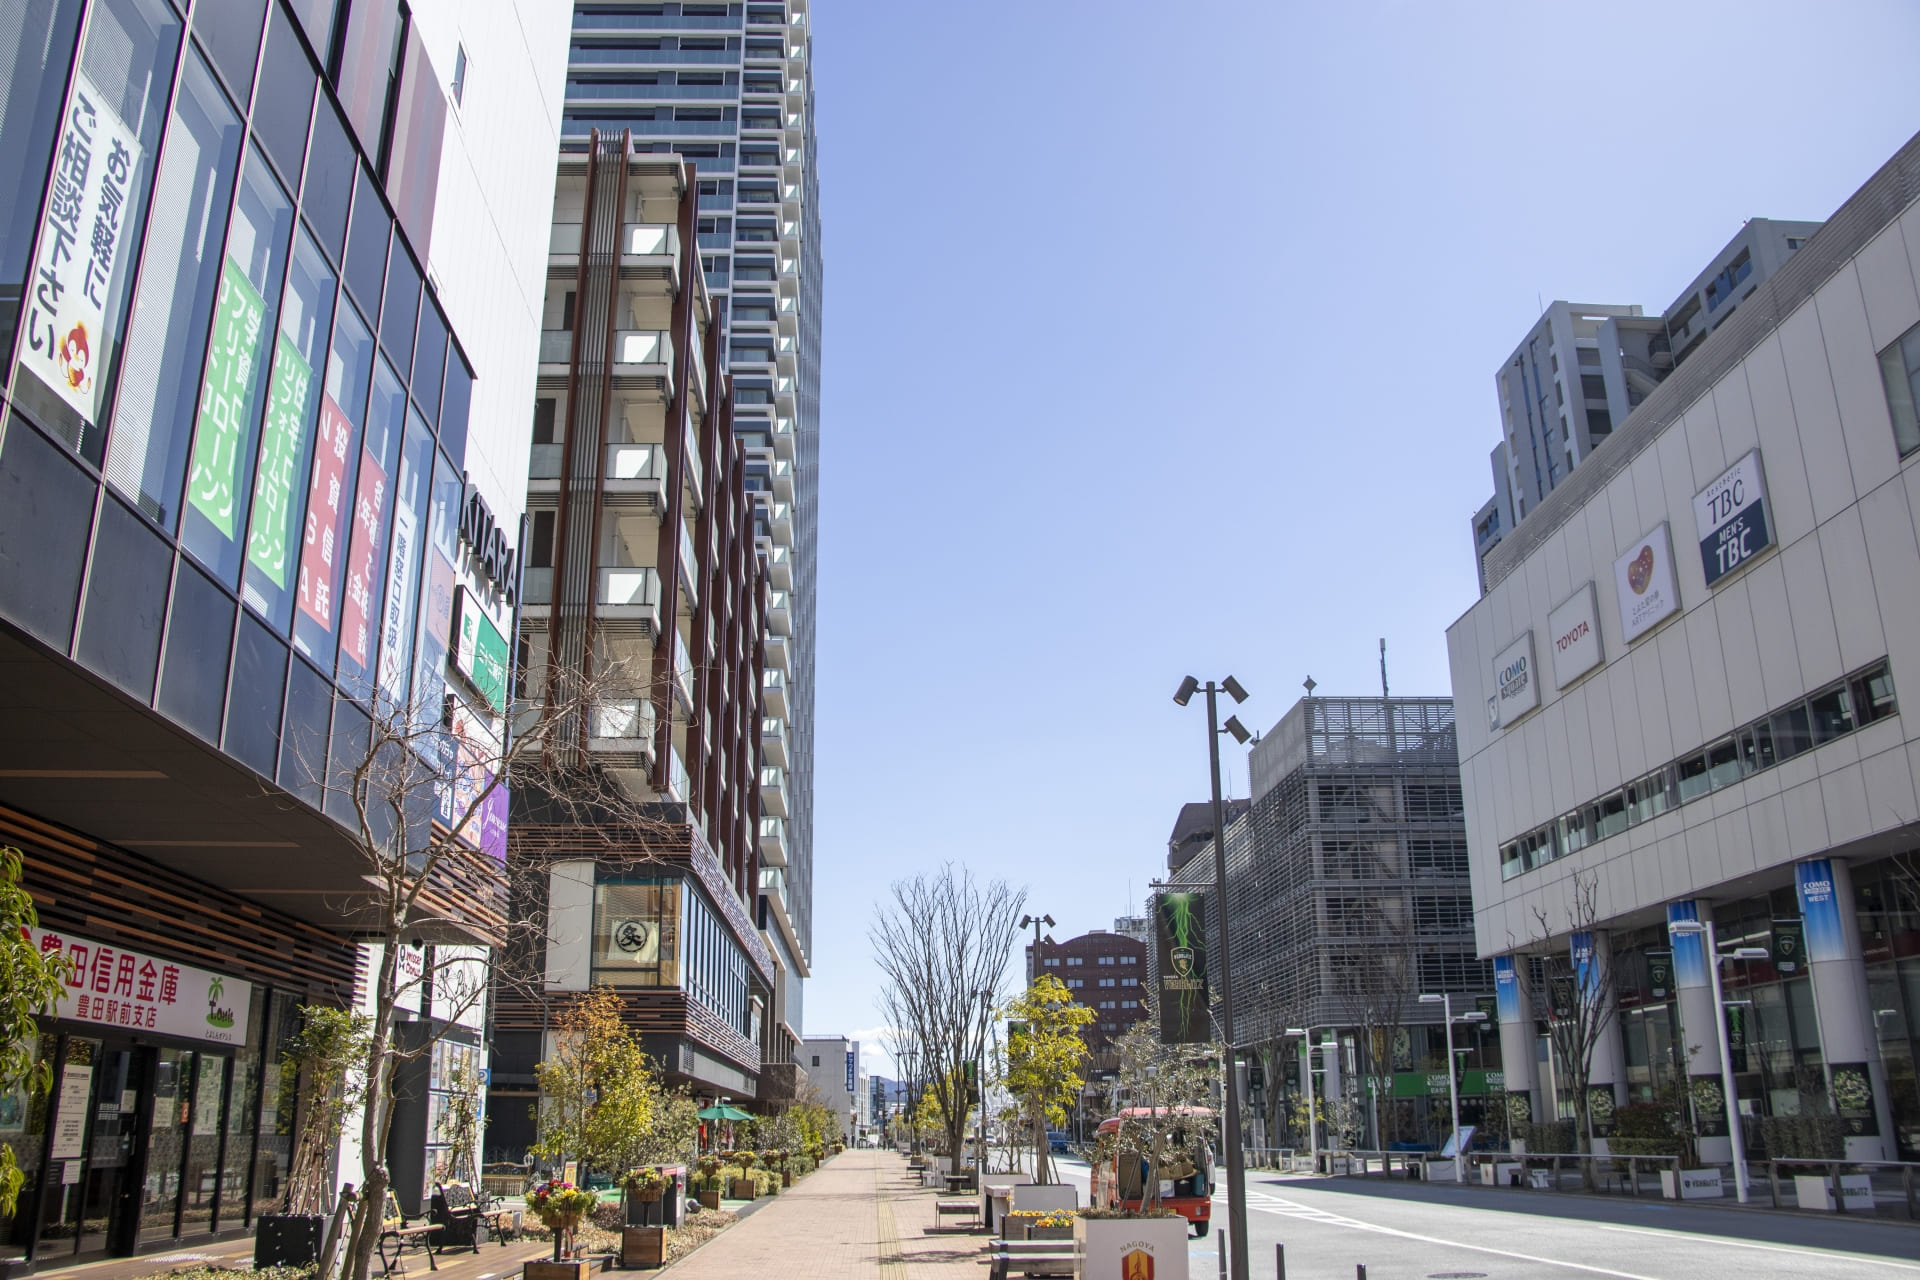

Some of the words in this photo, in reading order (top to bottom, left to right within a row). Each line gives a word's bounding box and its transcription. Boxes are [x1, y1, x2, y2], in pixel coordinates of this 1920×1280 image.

[29, 91, 97, 360] ご相談下さい
[84, 136, 131, 311] お気軽に
[201, 285, 247, 501] フリーローン
[258, 355, 295, 558] リフォームローン
[314, 421, 349, 621] 投資信託
[1707, 479, 1744, 525] TBC
[1716, 527, 1752, 574] TBC
[1720, 517, 1744, 545] MEN'S
[1556, 620, 1590, 654] TOYOTA
[1499, 656, 1527, 686] COMO
[1808, 894, 1829, 902] WEST
[76, 993, 157, 1029] 豊田駅前支店
[1120, 1240, 1154, 1252] NAGOYA
